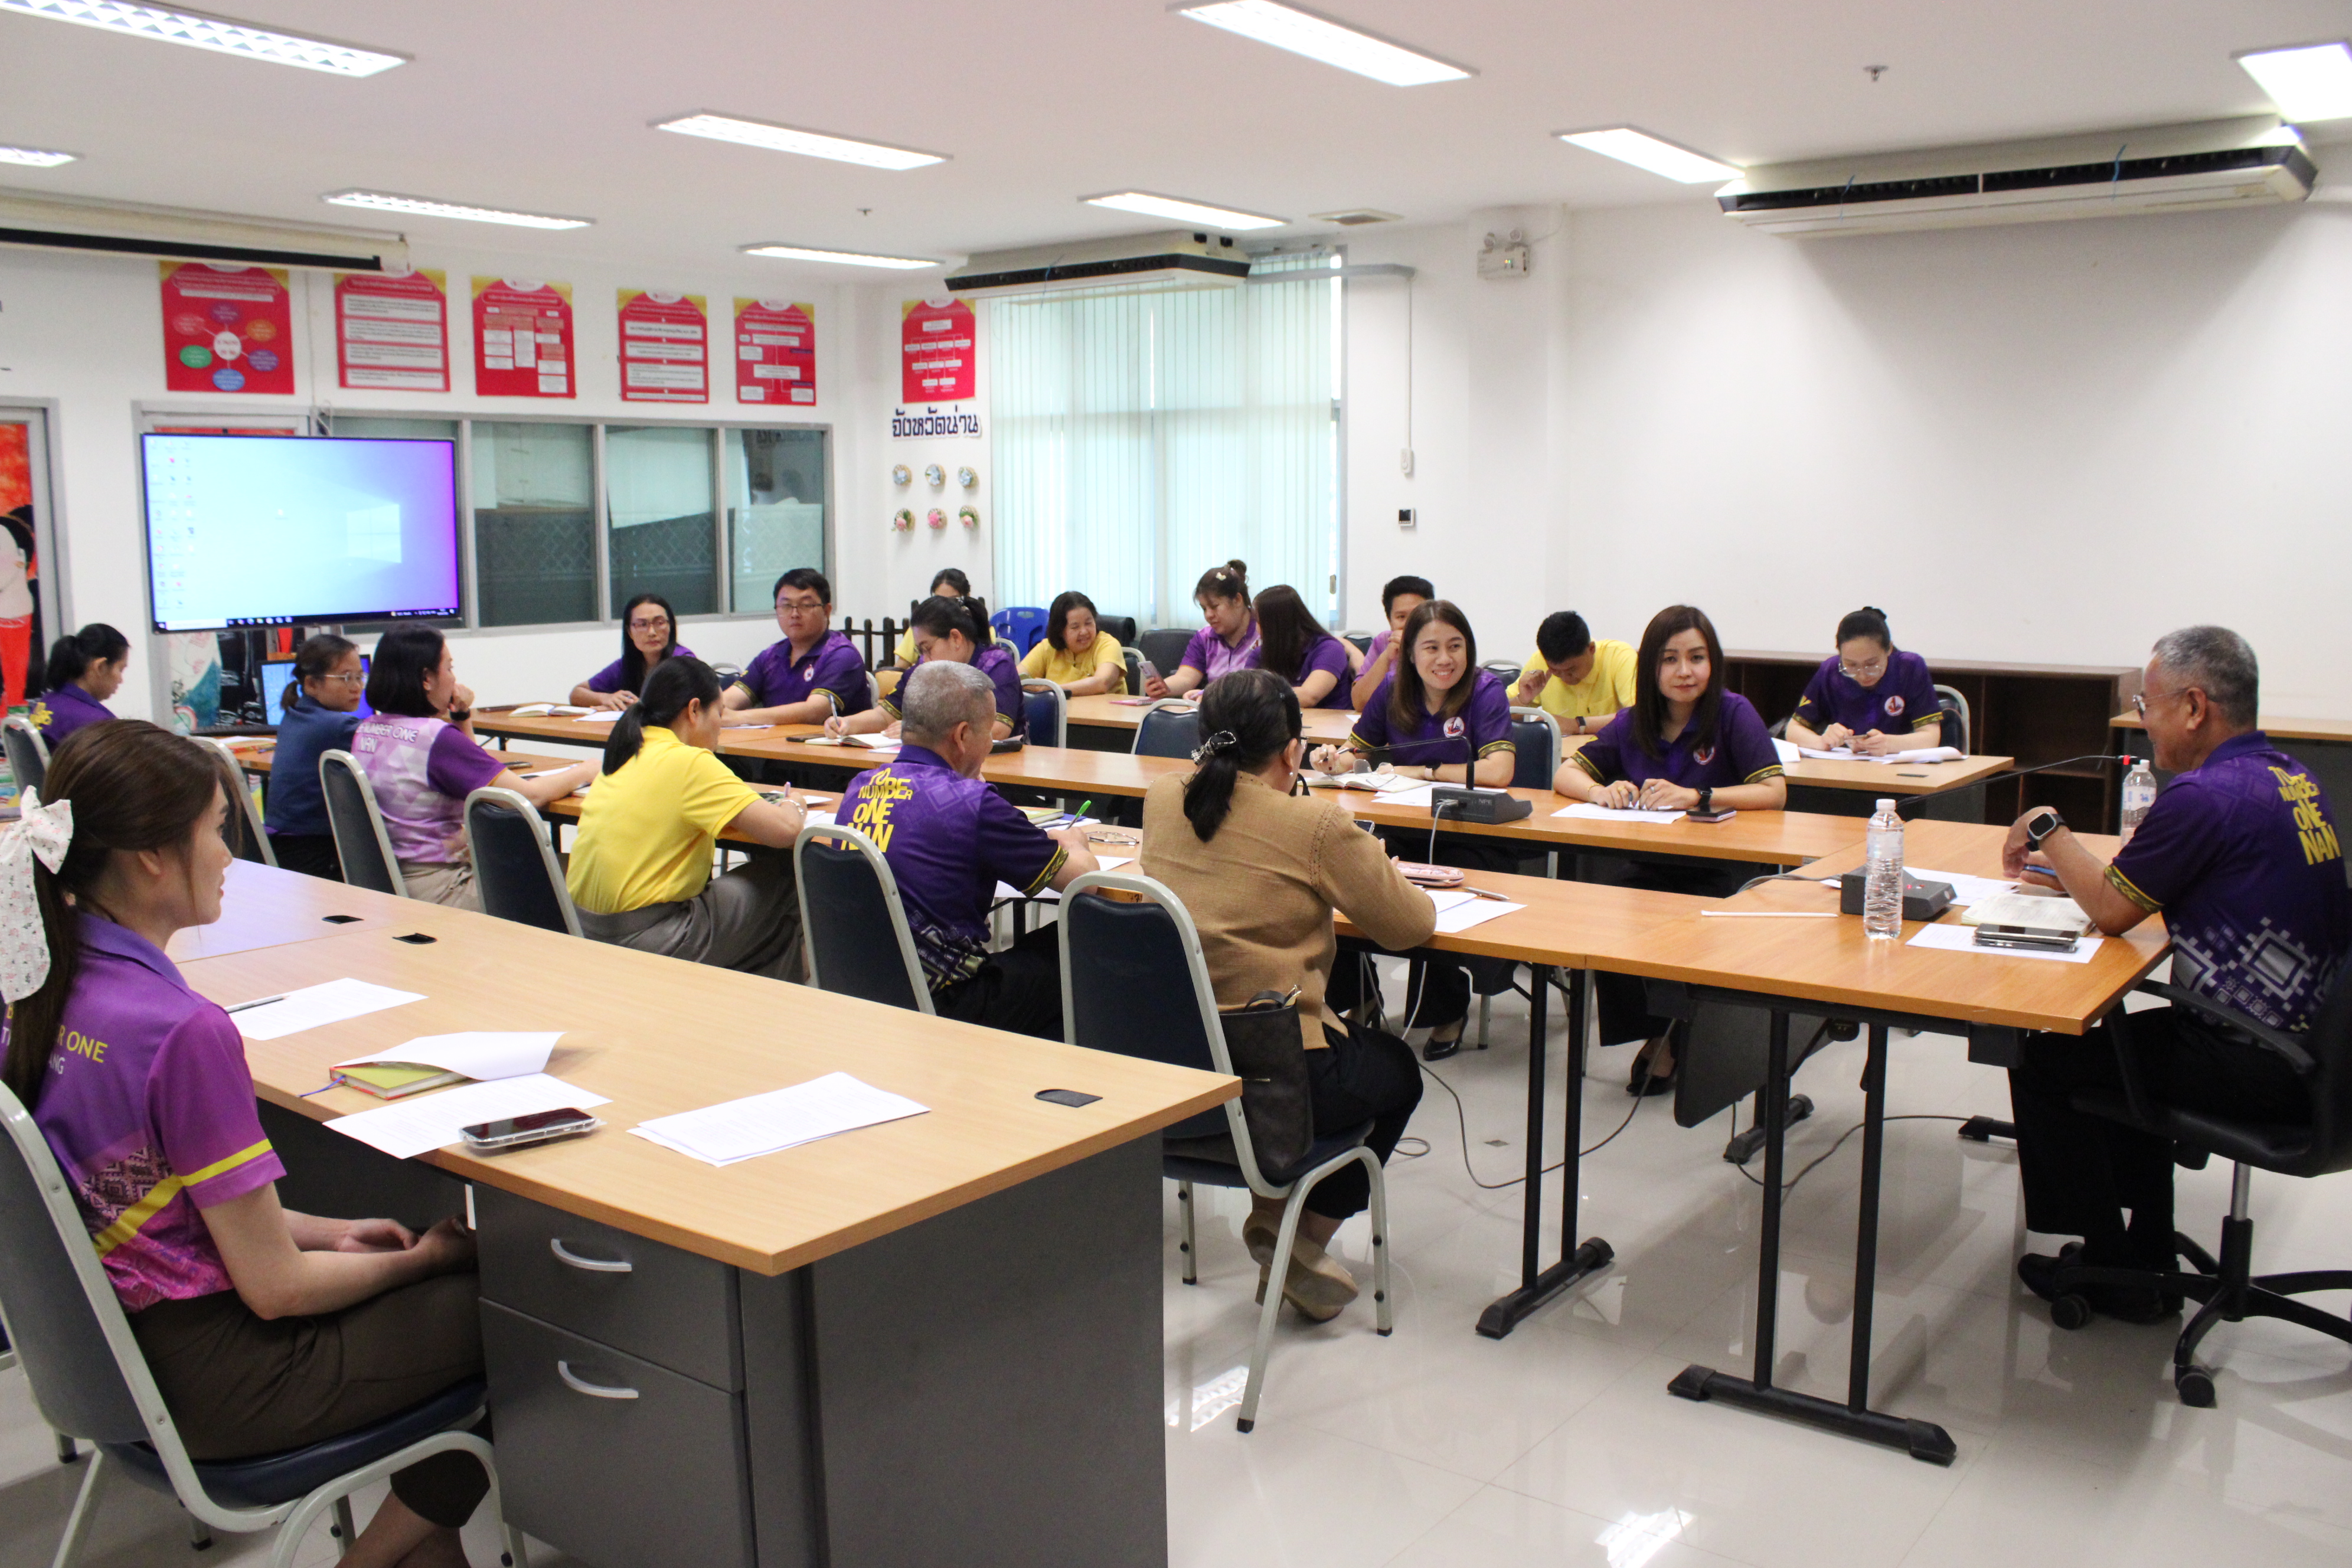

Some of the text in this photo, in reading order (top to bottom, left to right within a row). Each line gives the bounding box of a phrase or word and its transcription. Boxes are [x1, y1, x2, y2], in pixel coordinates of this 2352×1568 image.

[892, 404, 978, 437] จังหวัดน่าน
[392, 726, 419, 743] ONE
[869, 767, 911, 789] TO BE
[858, 786, 913, 801] NUMBER
[853, 798, 894, 824] ONE
[2293, 798, 2327, 831] ONE
[2298, 824, 2342, 865] NAN
[66, 1031, 109, 1063] ONE
